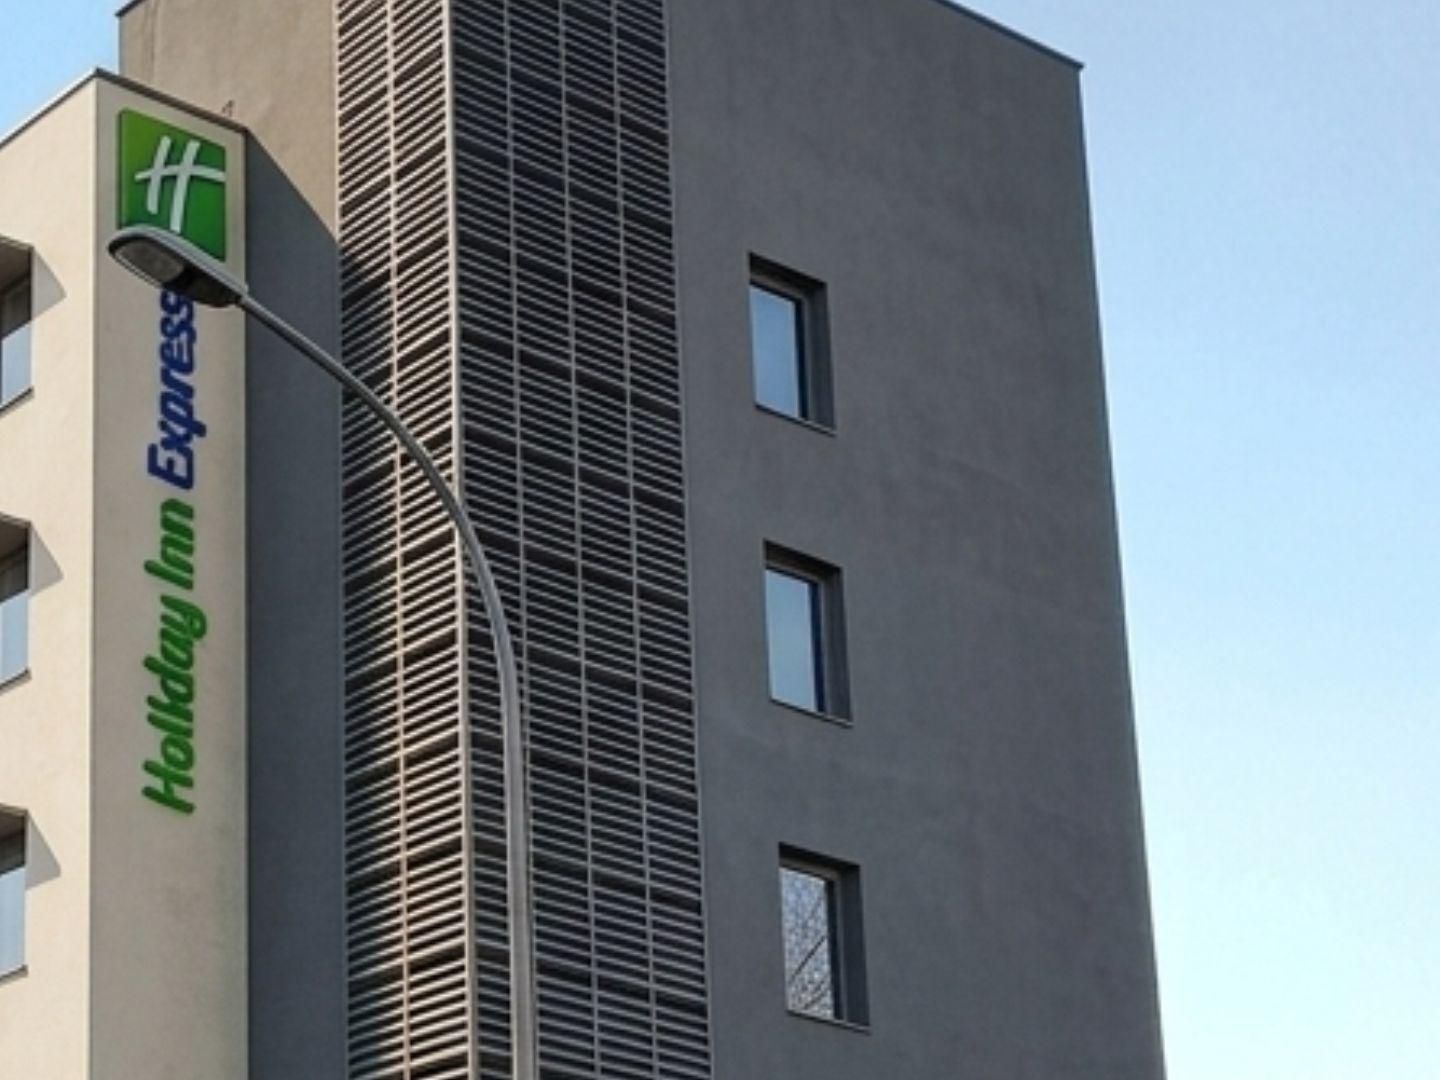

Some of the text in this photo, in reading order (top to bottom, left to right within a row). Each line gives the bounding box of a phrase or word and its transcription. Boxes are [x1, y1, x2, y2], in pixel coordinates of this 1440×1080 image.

[142, 287, 207, 814] Holiday Inn Express
